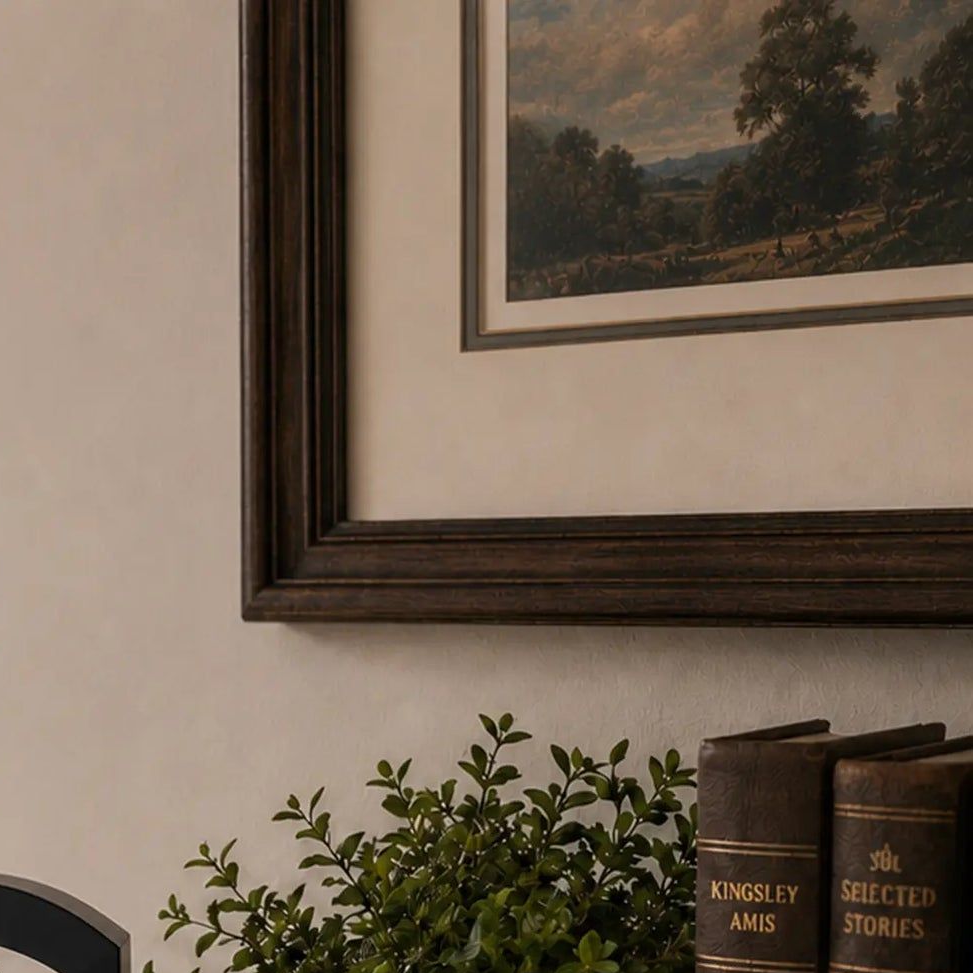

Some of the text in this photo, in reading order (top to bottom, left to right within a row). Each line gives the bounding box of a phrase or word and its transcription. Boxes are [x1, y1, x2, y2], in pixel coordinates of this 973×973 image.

[711, 880, 799, 905] KINGSLEY
[730, 911, 776, 933] AMIS
[843, 911, 925, 940] STORIES
